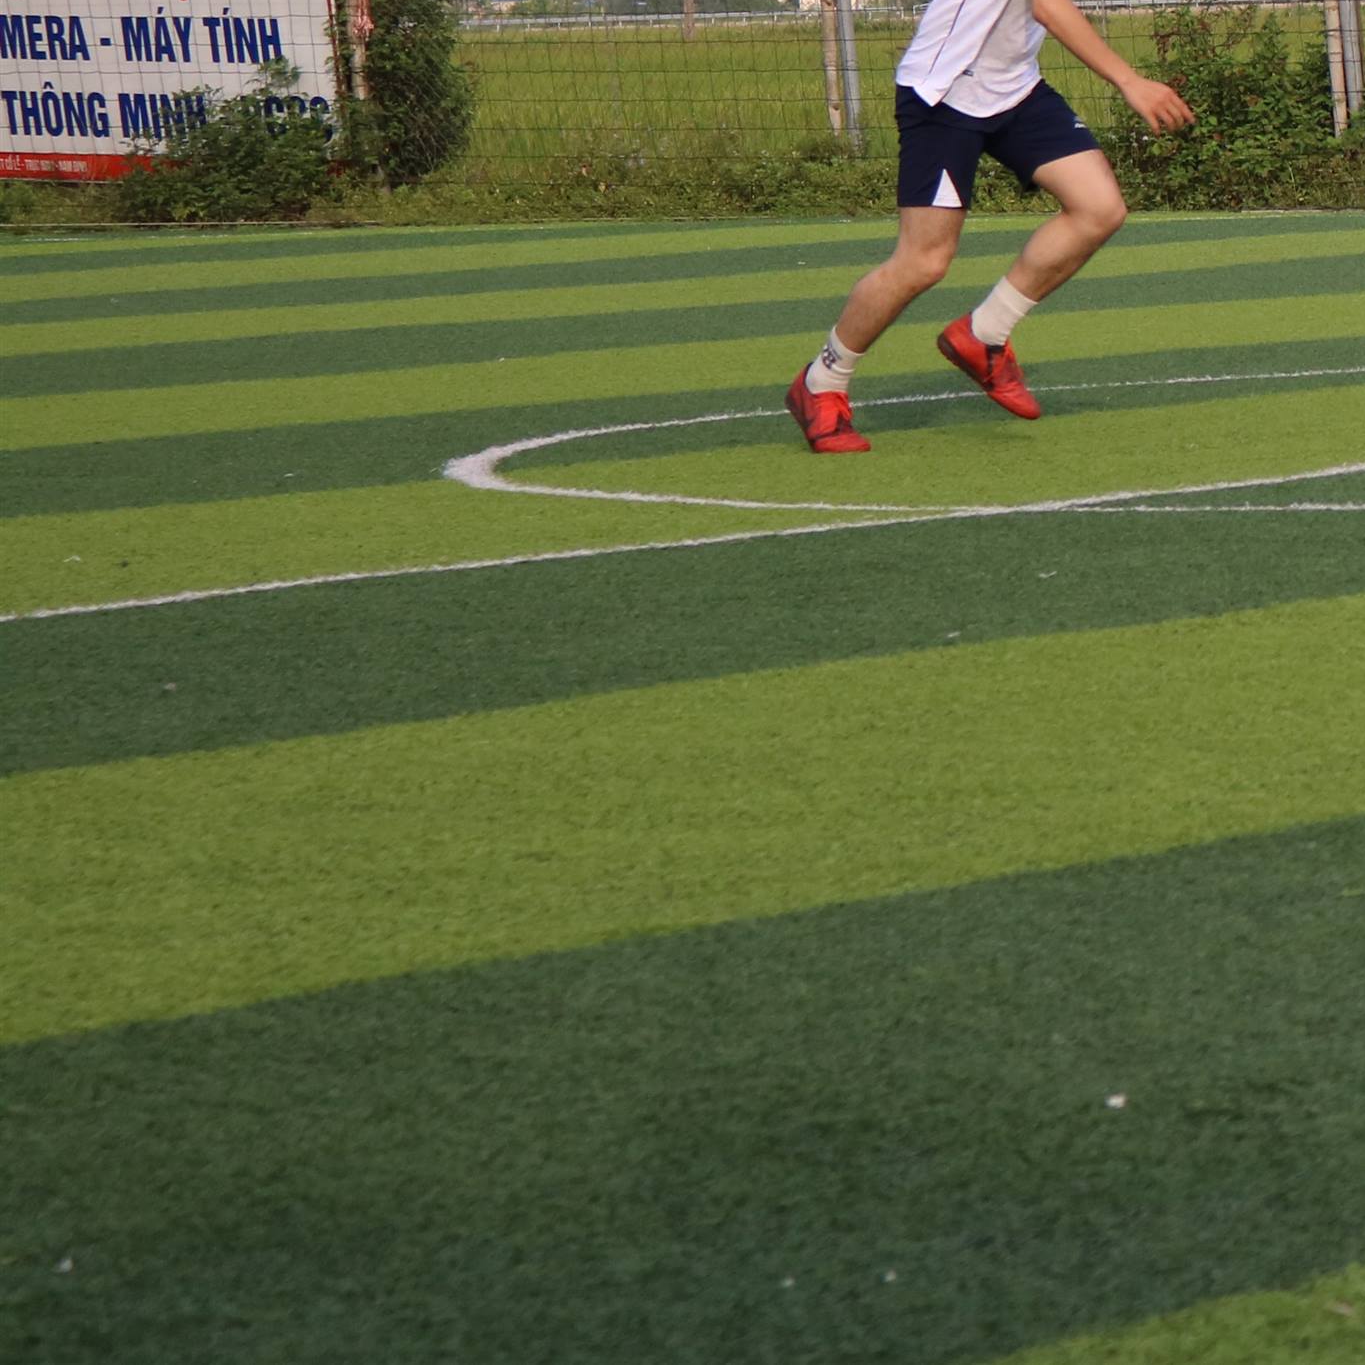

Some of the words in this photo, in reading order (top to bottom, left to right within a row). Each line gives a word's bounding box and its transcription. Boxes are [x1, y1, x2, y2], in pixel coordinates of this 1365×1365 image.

[0, 14, 91, 61] MERA
[120, 6, 192, 62] MÁY
[202, 7, 283, 64] TÍNH
[1, 81, 110, 137] THÔNG
